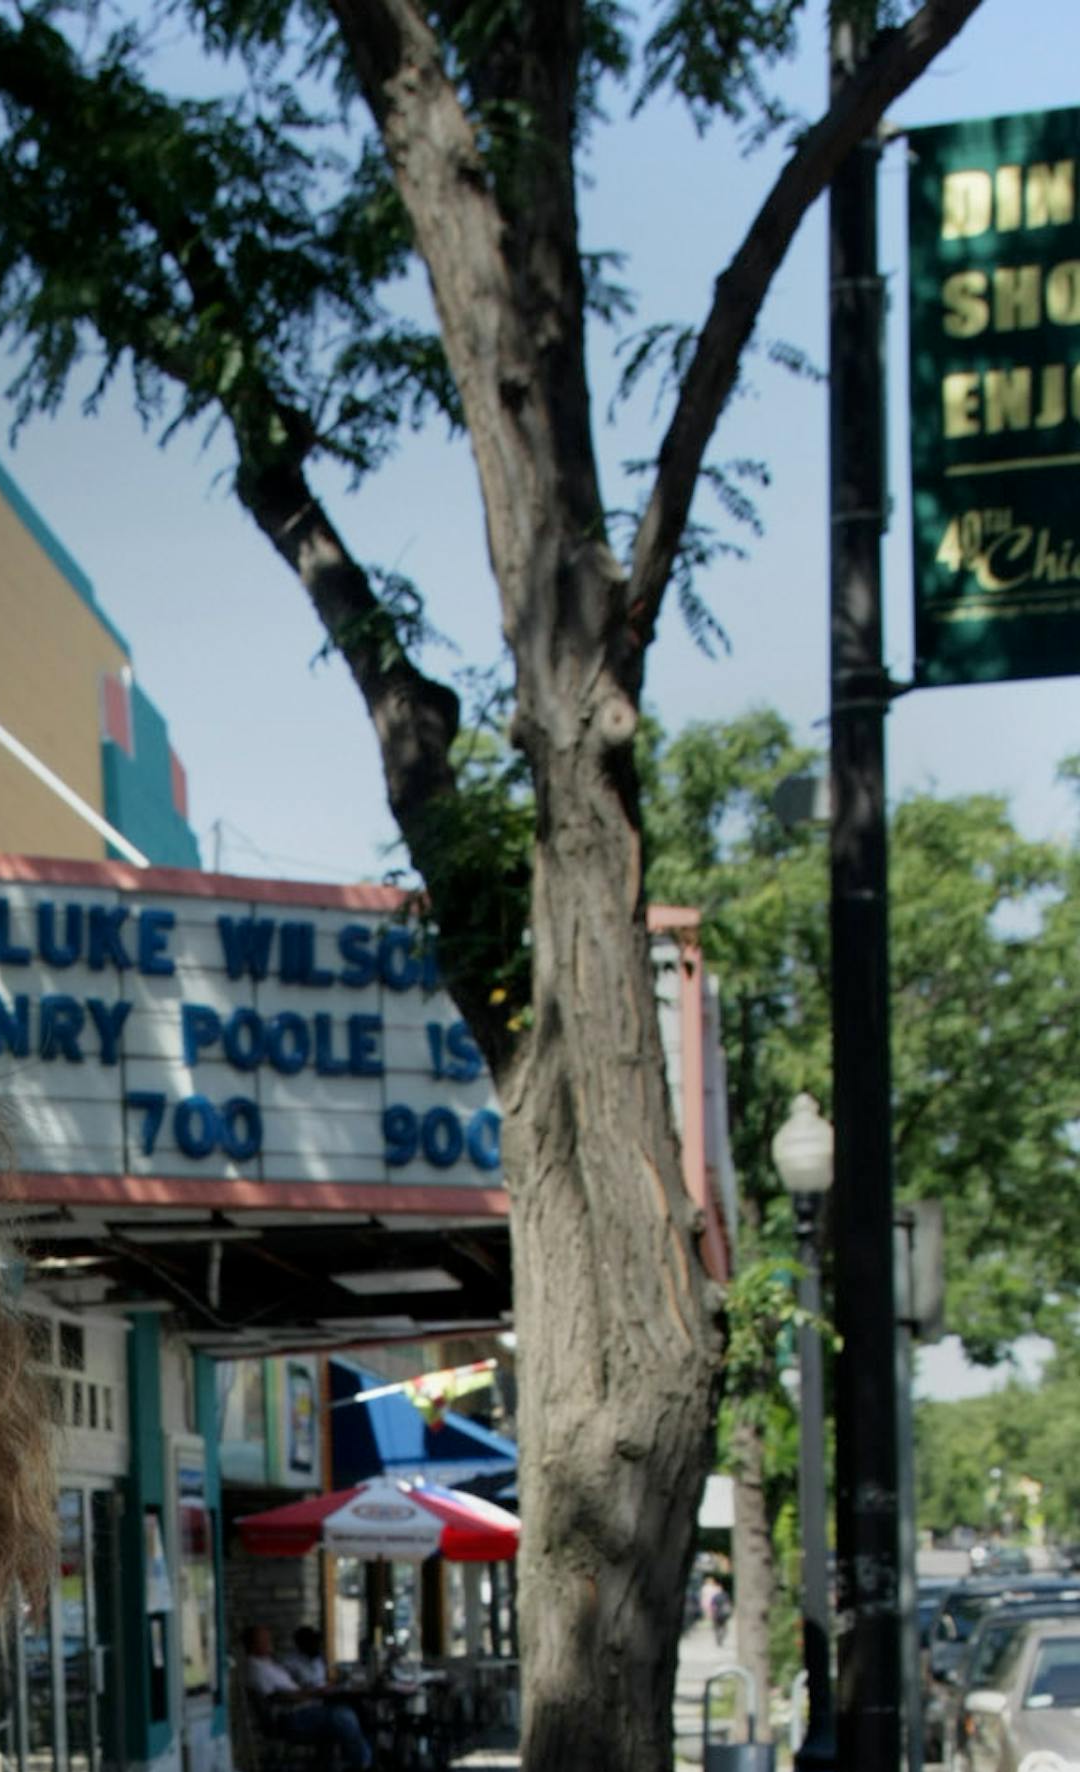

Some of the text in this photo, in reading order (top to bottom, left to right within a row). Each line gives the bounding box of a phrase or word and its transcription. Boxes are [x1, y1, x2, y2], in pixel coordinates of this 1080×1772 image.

[942, 362, 1080, 441] ENJ
[181, 1003, 384, 1077] POOLE
[426, 1019, 485, 1082] IS
[123, 1091, 262, 1162] 700
